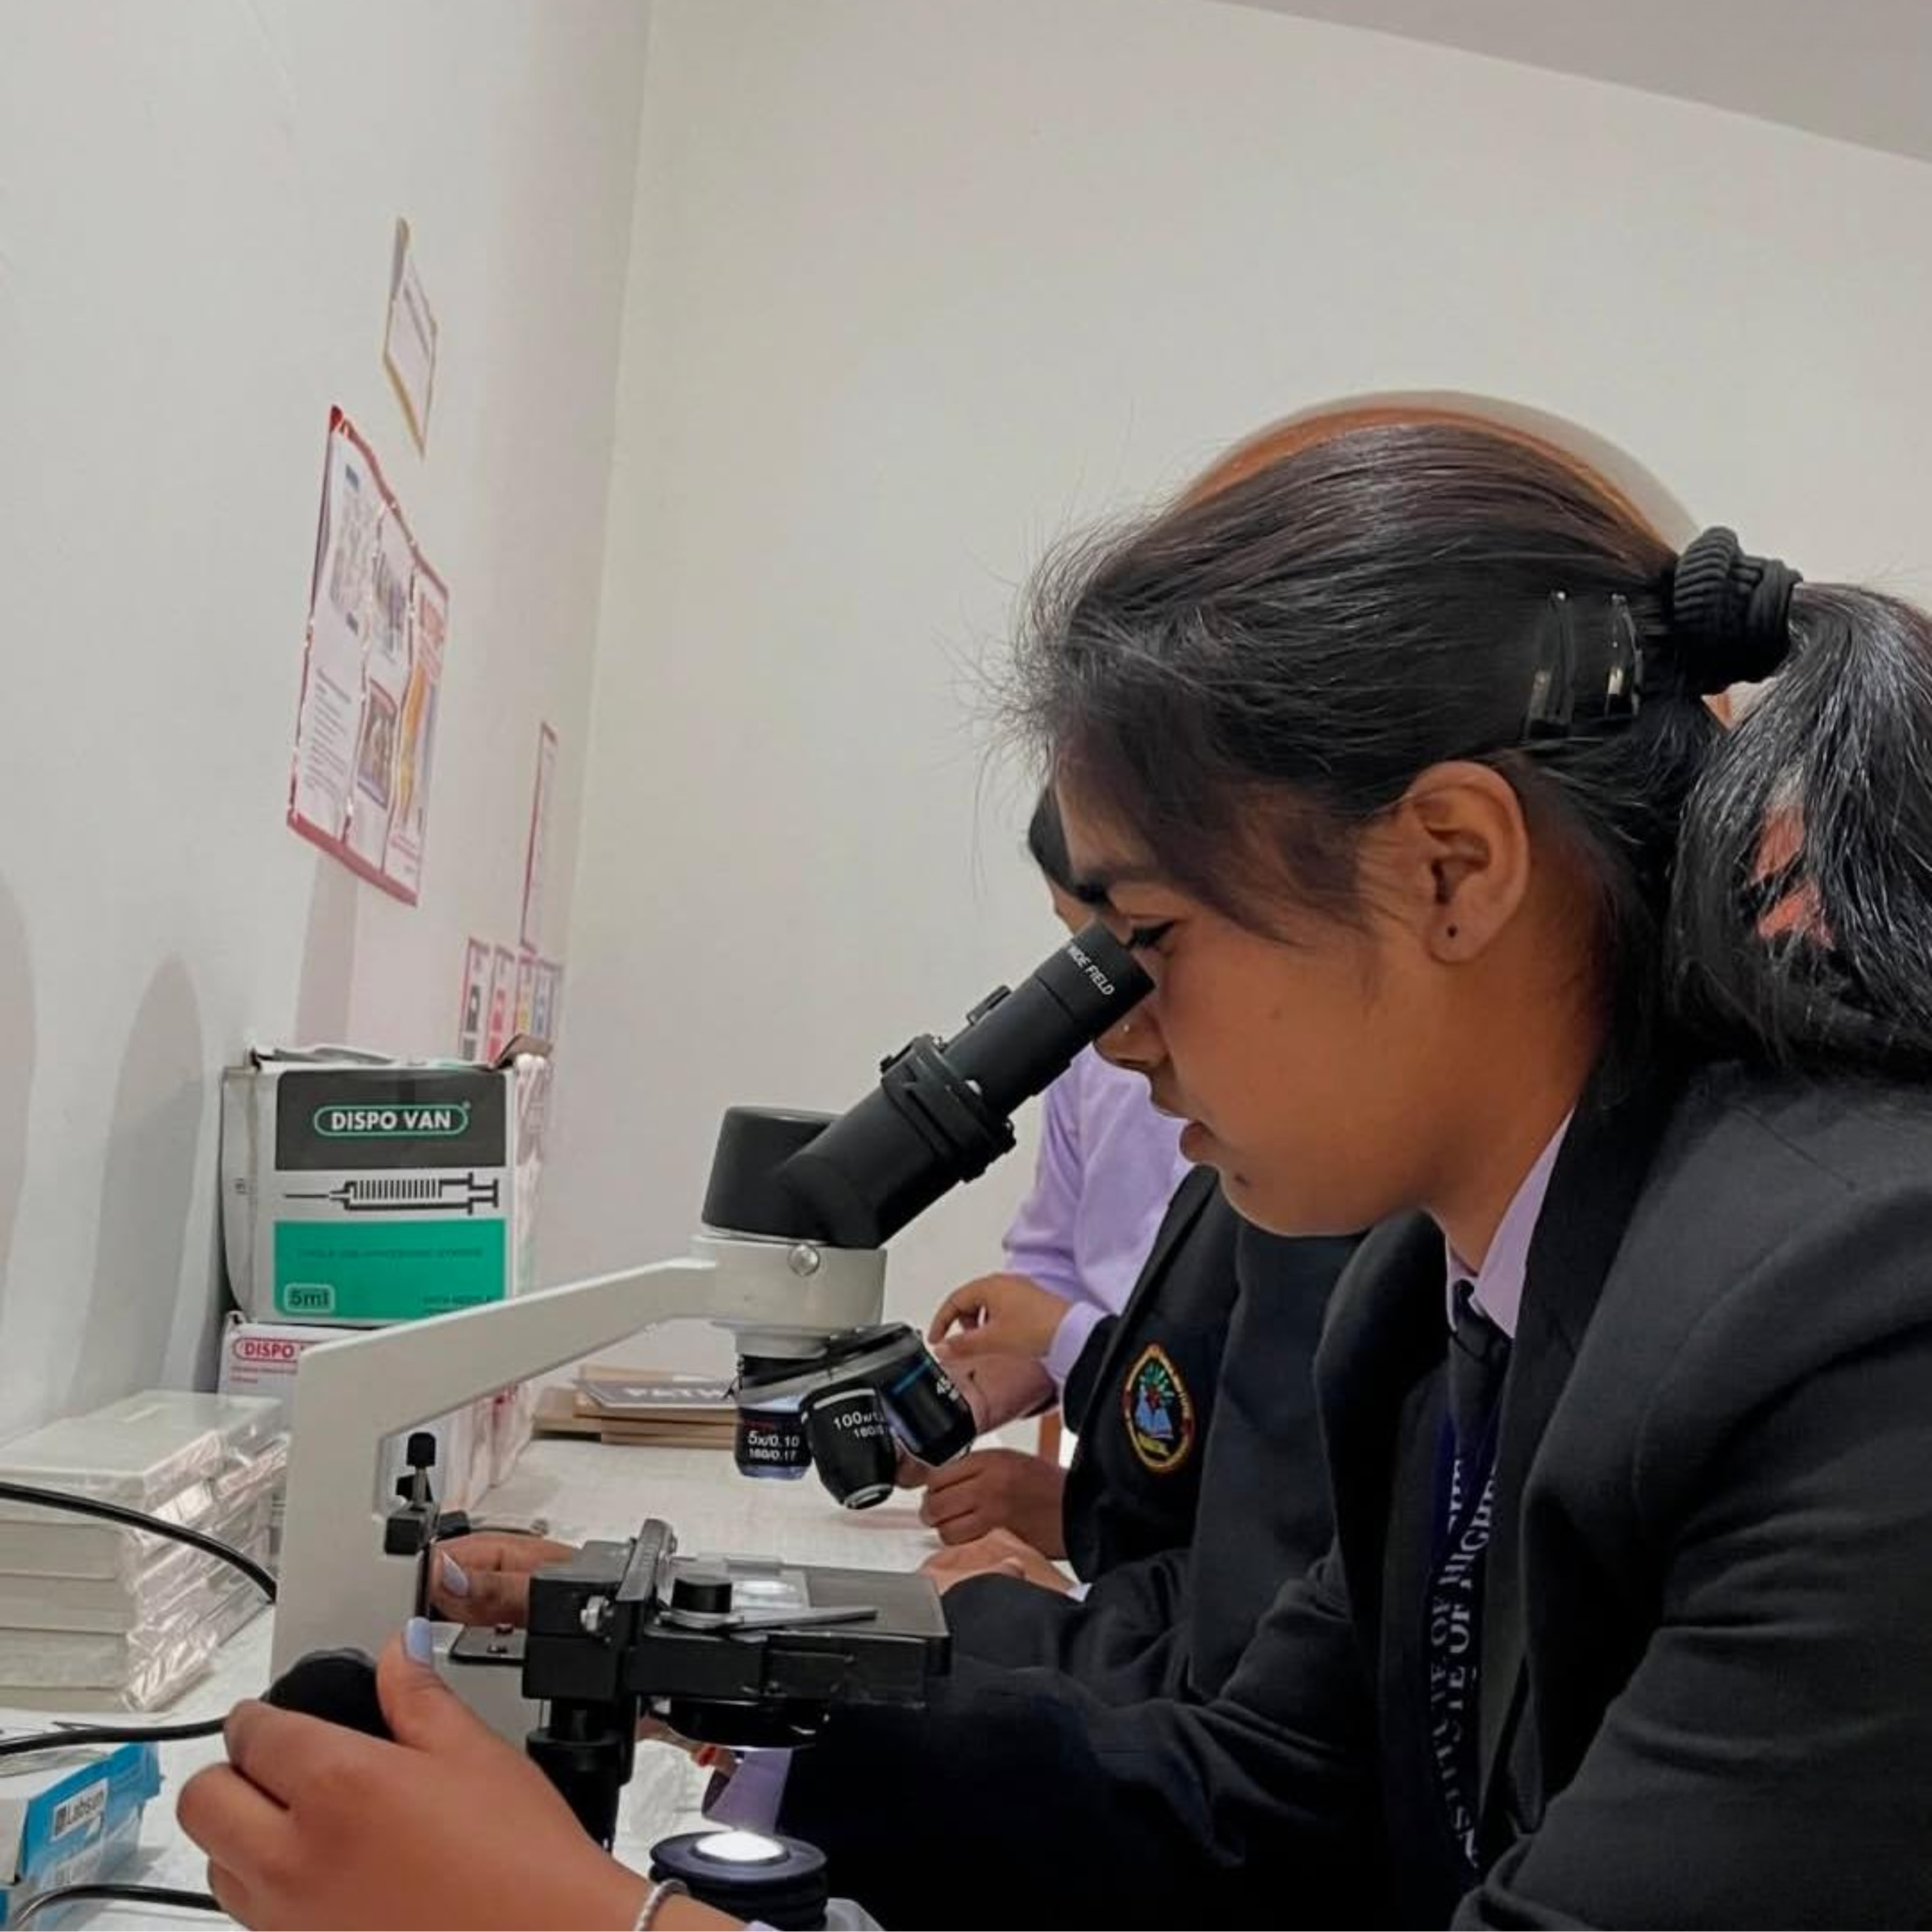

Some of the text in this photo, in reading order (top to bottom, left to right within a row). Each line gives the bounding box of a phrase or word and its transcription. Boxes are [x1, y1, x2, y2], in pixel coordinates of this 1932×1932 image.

[1085, 965, 1116, 995] FIELD
[331, 1111, 451, 1131] DISPO VAN
[288, 1287, 329, 1307] 5ml
[244, 1342, 294, 1358] DISPO
